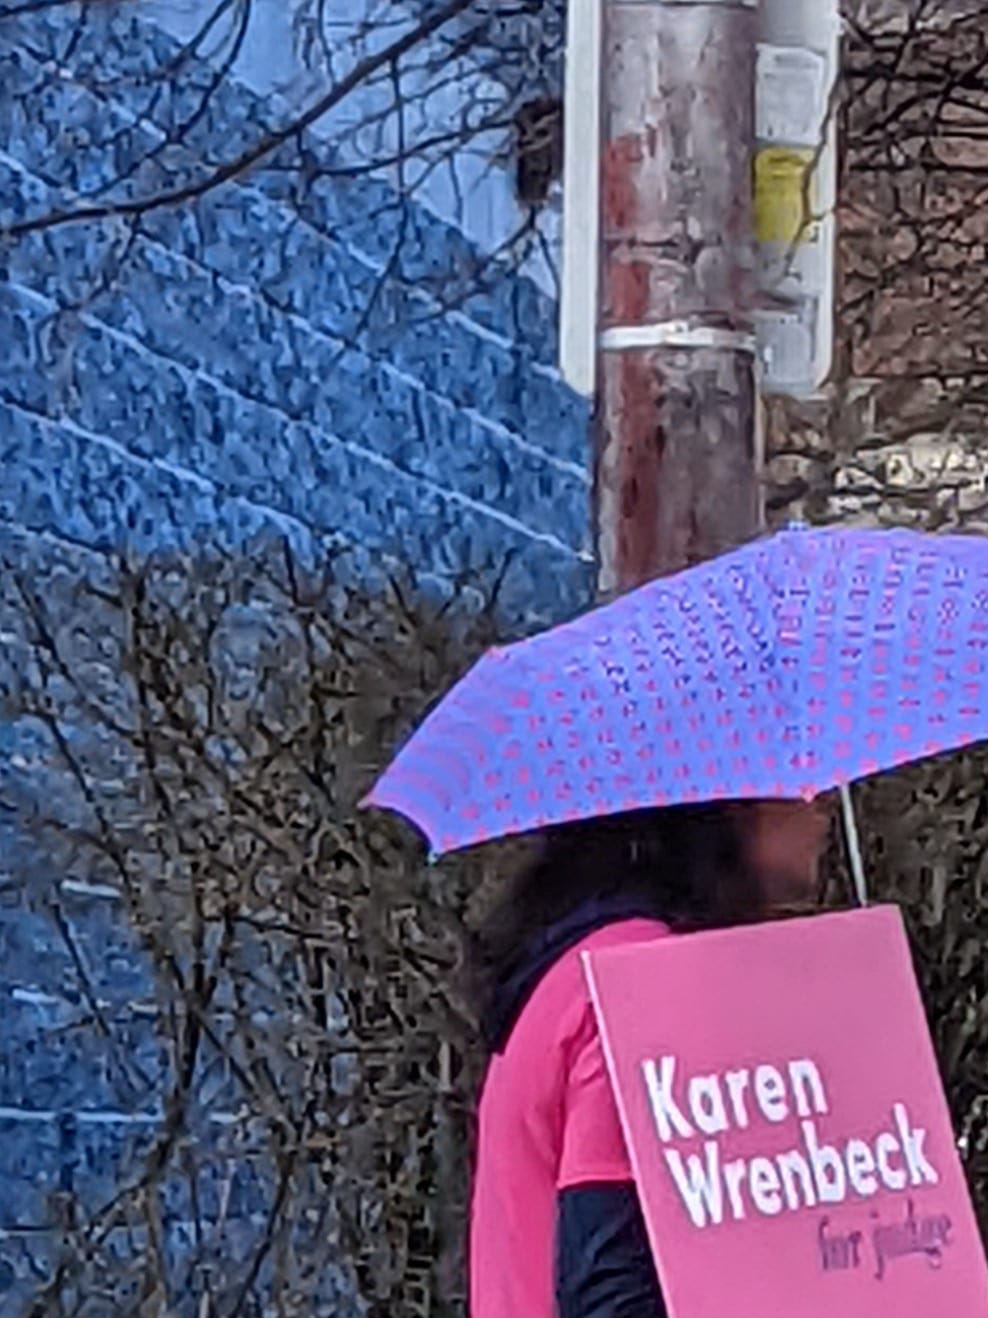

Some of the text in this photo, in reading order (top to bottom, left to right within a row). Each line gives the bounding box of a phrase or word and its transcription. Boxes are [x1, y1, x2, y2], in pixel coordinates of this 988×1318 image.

[641, 1055, 828, 1142] Karen
[663, 1102, 939, 1228] Wrenbeck
[816, 1200, 953, 1281] for judge
